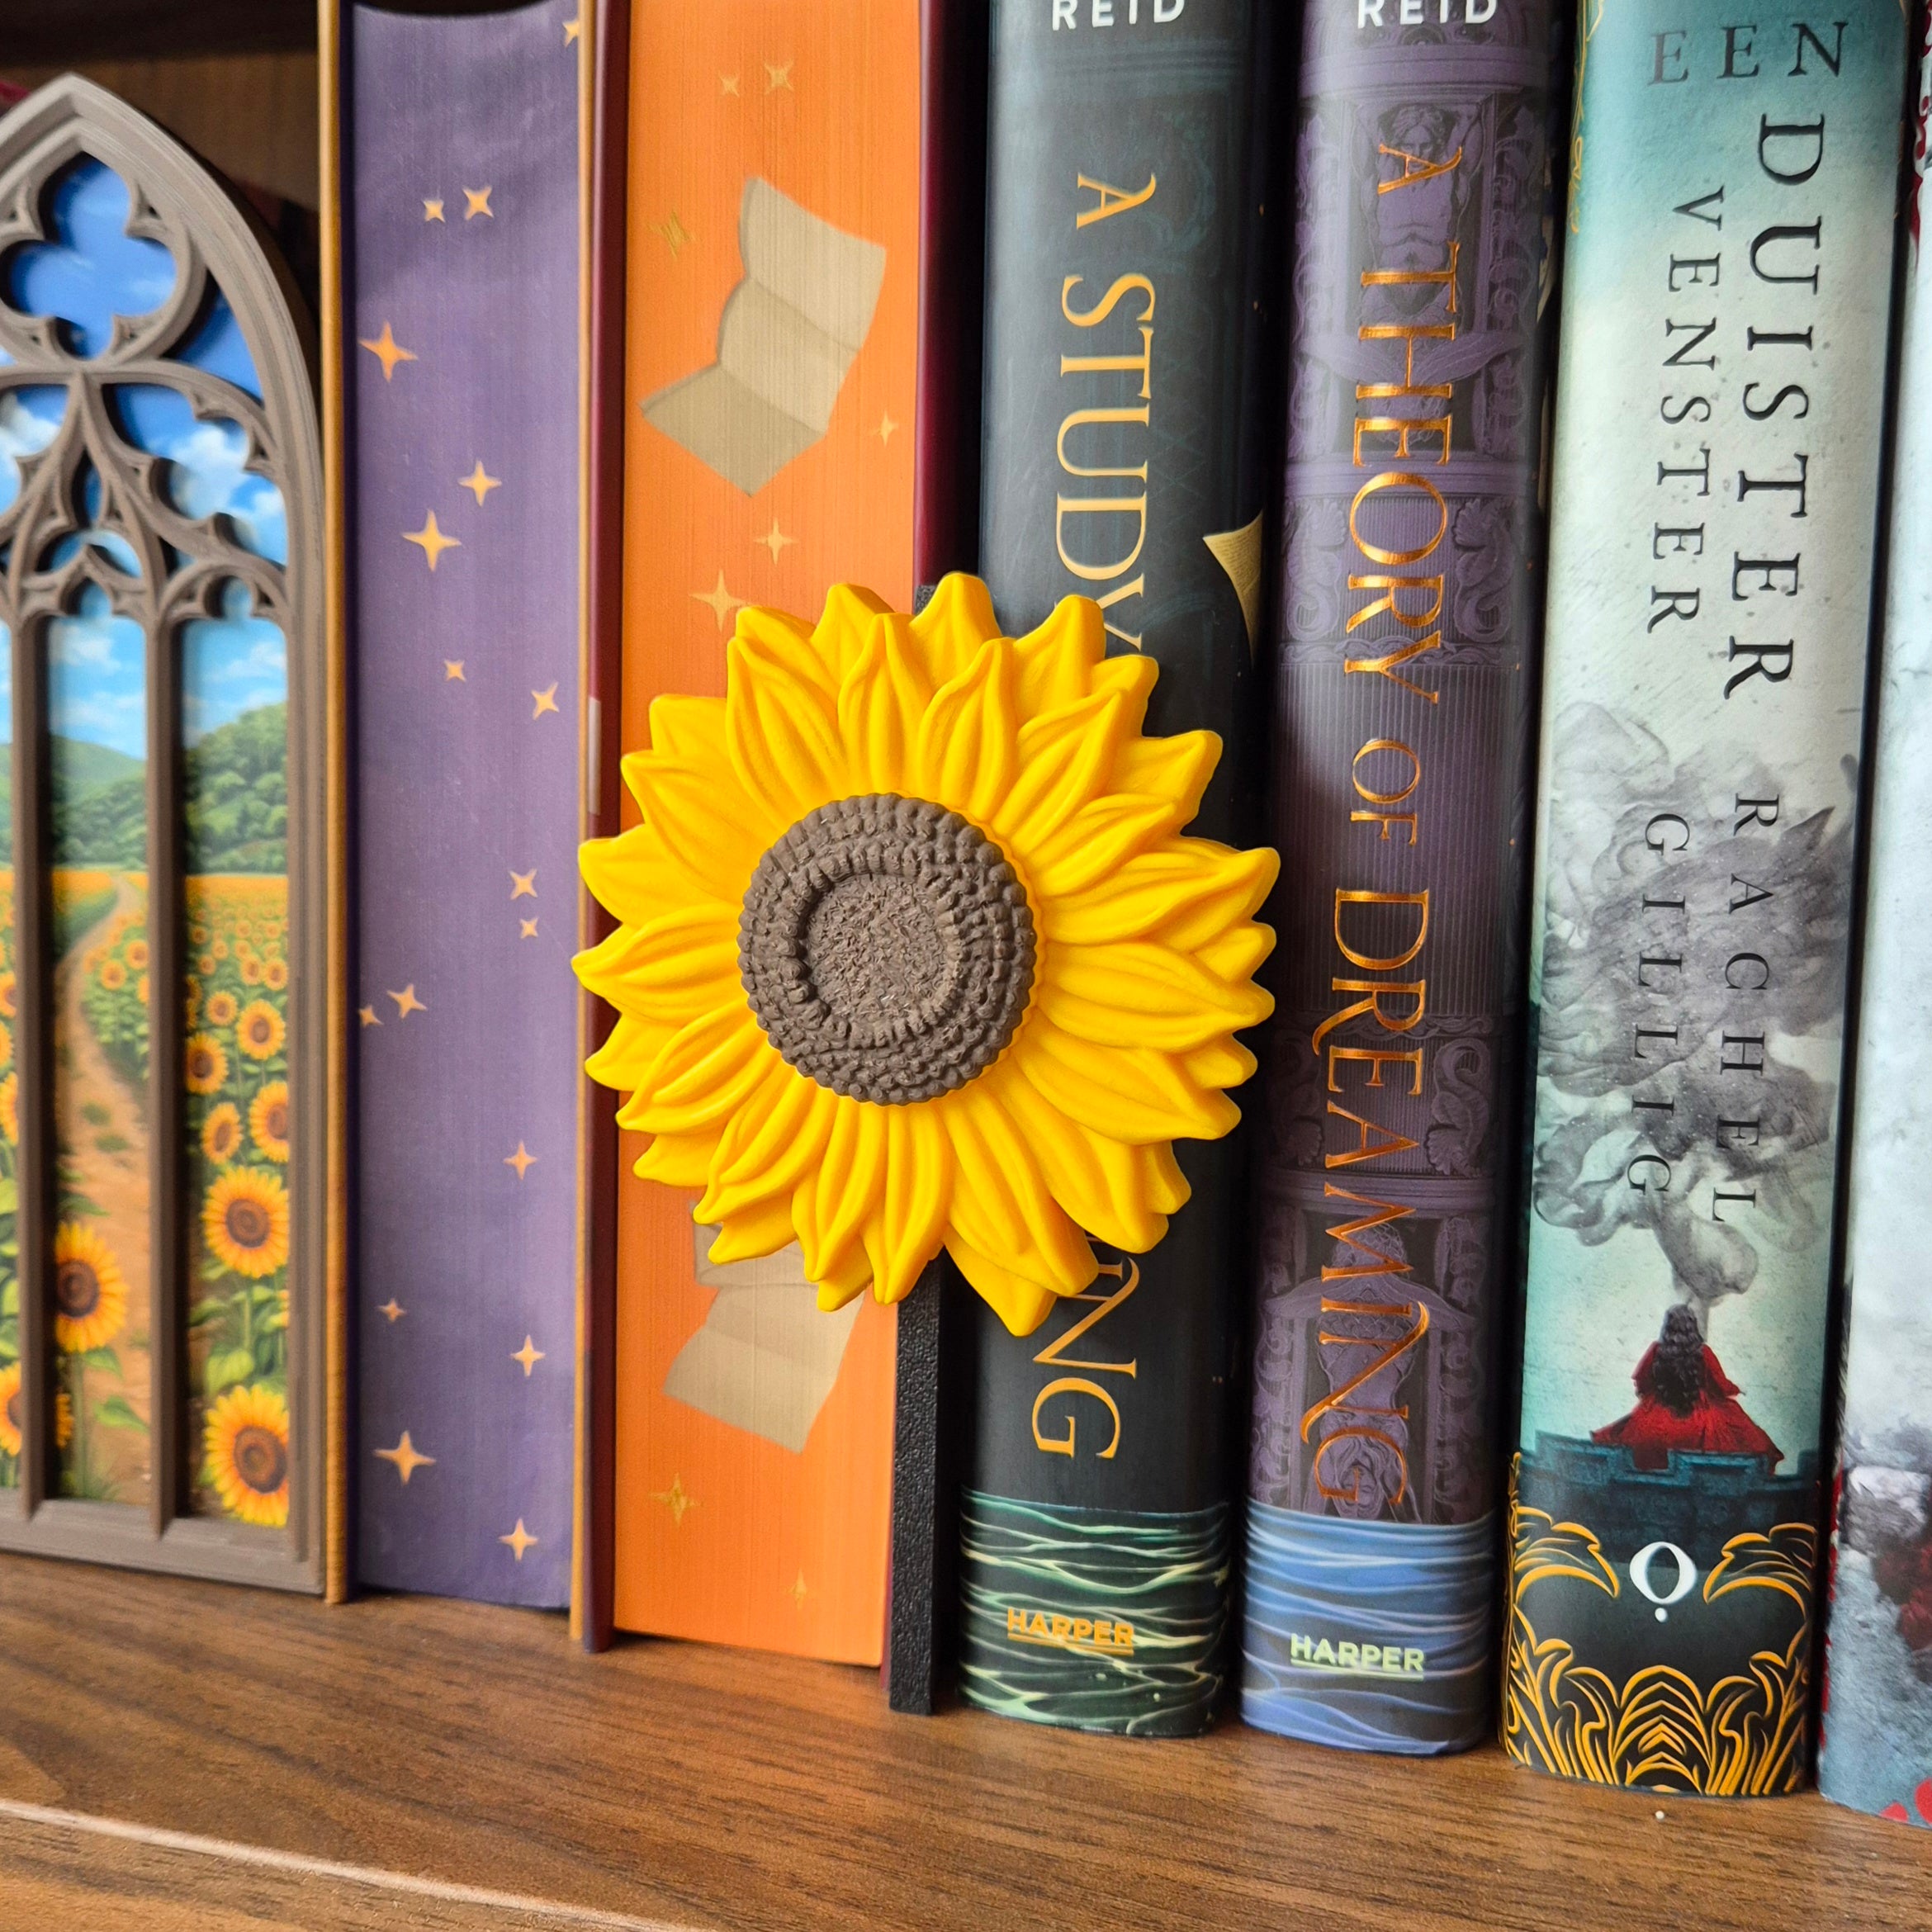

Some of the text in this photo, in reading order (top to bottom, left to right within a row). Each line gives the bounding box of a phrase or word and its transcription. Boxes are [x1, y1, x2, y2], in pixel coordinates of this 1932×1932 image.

[1052, 0, 1185, 31] REID
[1357, 0, 1497, 29] REID
[1647, 21, 1849, 85] EEN
[1077, 173, 1156, 230] A
[1647, 185, 1726, 634] VENSTER
[1723, 113, 1825, 700] DUISTER
[1300, 143, 1462, 1504] A THEORY OF DREAMING
[1627, 813, 1691, 1196] GILLIG
[1712, 793, 1779, 1223] RACHEL
[1007, 1609, 1134, 1647] HARPER
[1290, 1634, 1425, 1673] HARPER
